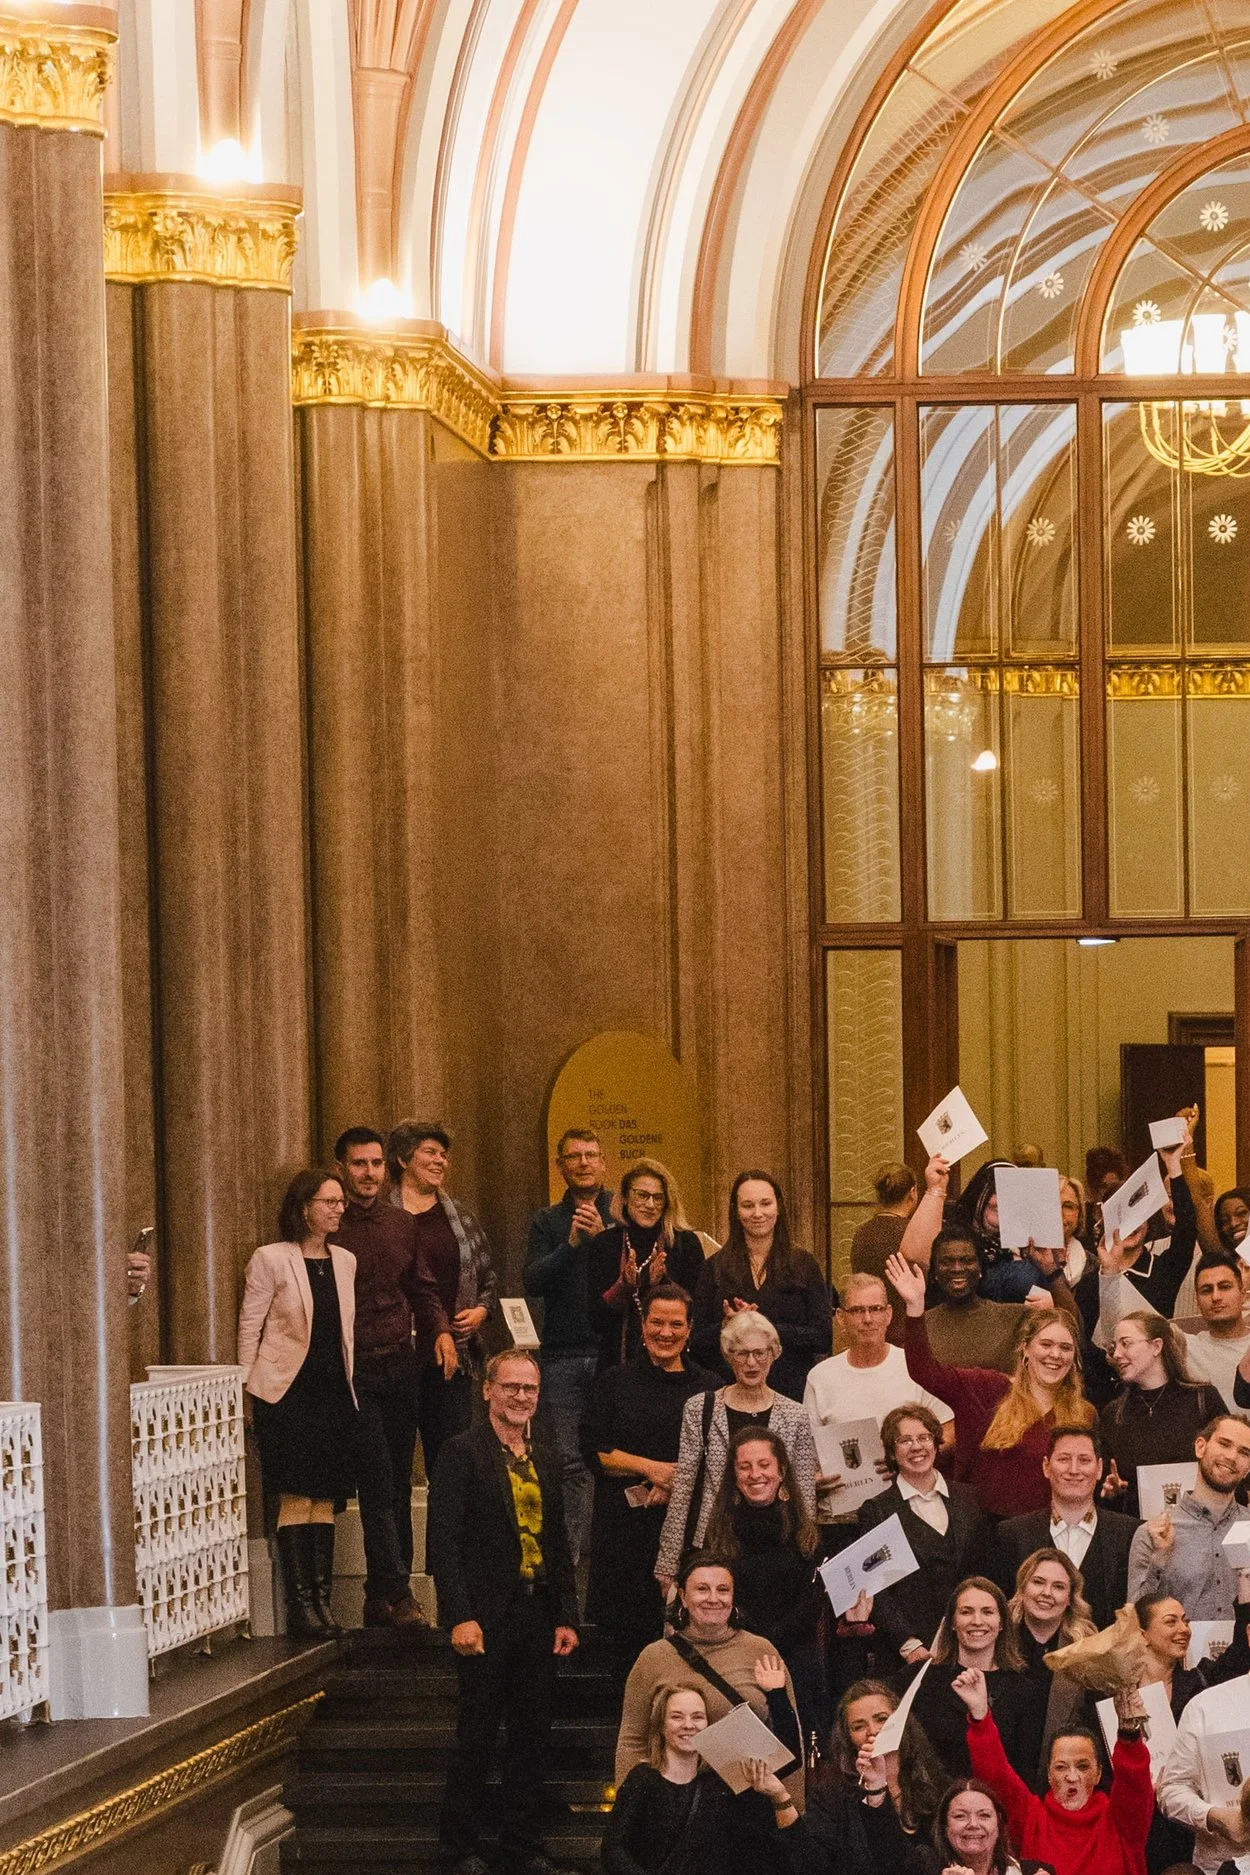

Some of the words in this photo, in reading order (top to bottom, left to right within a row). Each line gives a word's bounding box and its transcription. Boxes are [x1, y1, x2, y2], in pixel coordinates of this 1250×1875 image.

[588, 1089, 604, 1099] THE
[588, 1104, 628, 1114] GOLDEN
[619, 1119, 637, 1129] DAS
[619, 1133, 663, 1144] GOLDENE
[620, 1149, 646, 1159] BUCH
